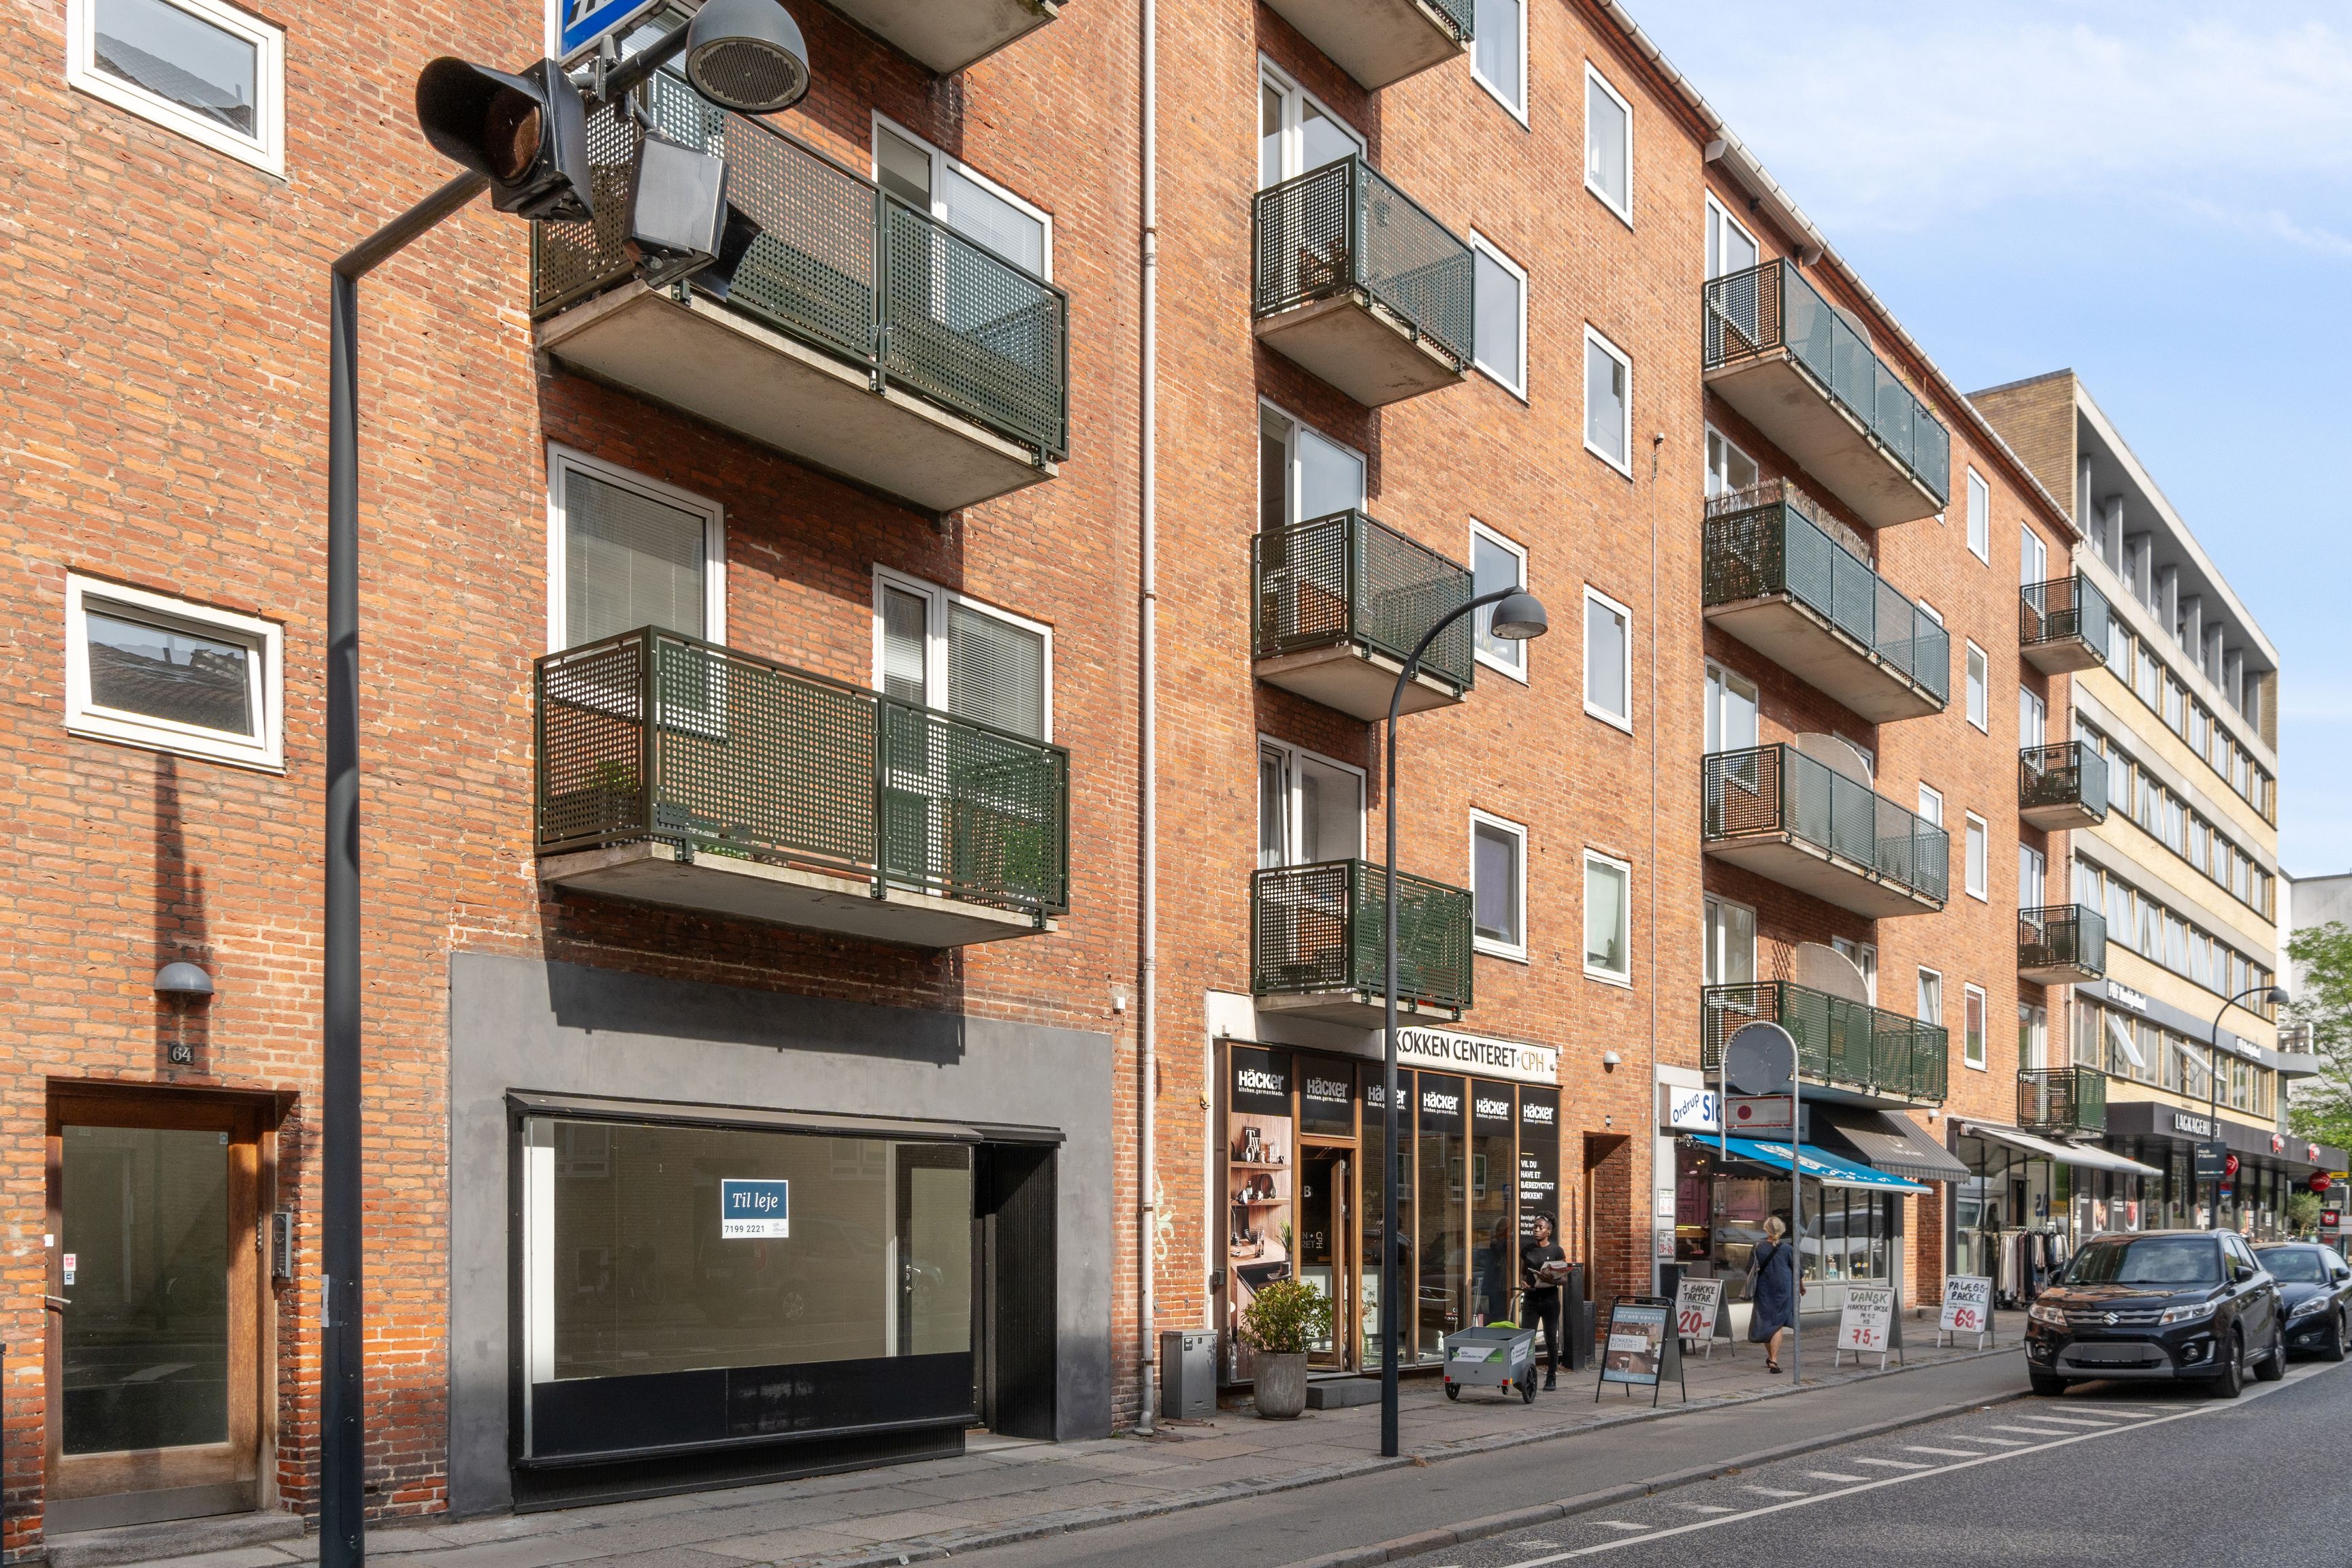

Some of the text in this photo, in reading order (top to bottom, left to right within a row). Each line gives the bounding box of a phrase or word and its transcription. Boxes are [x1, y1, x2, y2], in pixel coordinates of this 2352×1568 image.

[172, 1046, 191, 1062] 64
[1453, 1039, 1516, 1068] CENTERET
[1521, 1050, 1544, 1073] CPH
[1673, 1093, 1699, 1123] Ordrup
[1520, 1160, 1537, 1169] VIL DU
[1520, 1171, 1541, 1179] HAVE ET
[1520, 1191, 1543, 1200] KØKKEN?
[733, 1192, 779, 1212] Til leje
[725, 1225, 744, 1233] 7199
[1690, 1284, 1715, 1294] BAKKE
[1684, 1292, 1711, 1303] TARTAR
[1851, 1292, 1888, 1304] DANSK
[1951, 1291, 1982, 1302] PAKKE
